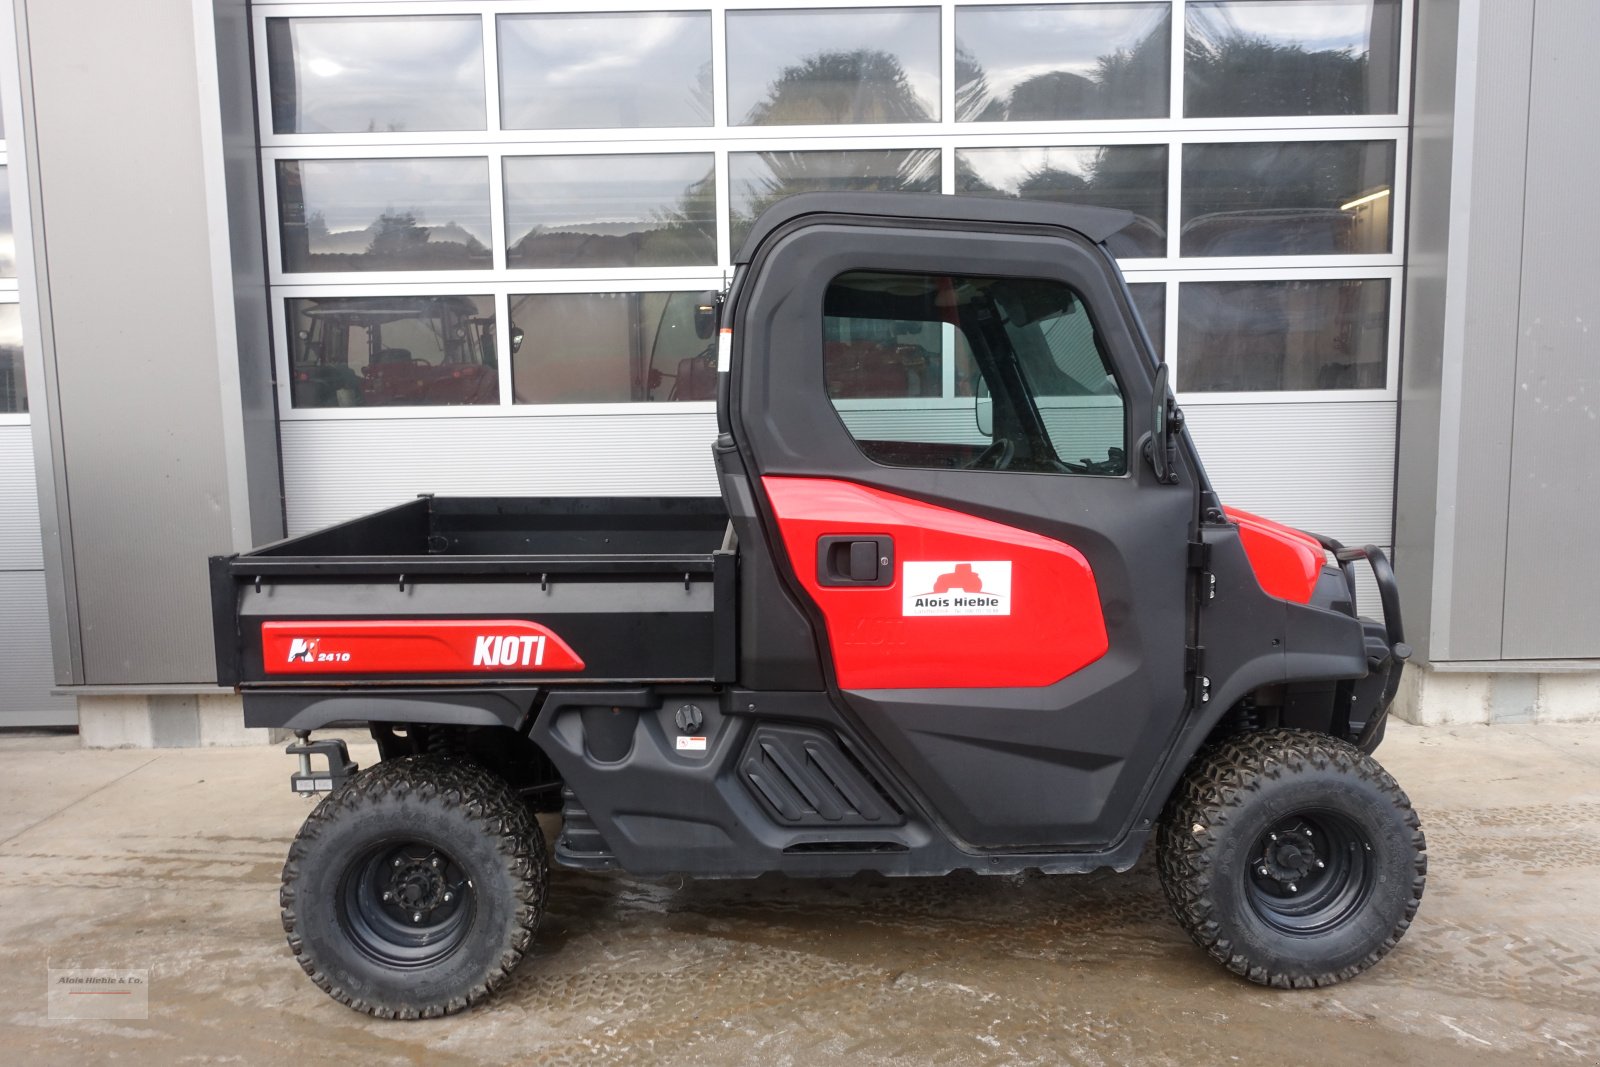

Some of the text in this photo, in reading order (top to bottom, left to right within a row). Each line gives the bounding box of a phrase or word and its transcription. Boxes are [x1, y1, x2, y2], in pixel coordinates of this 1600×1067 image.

[915, 598, 999, 607] Alois Hieble
[473, 635, 546, 666] KIOTI
[317, 652, 351, 662] 2410
